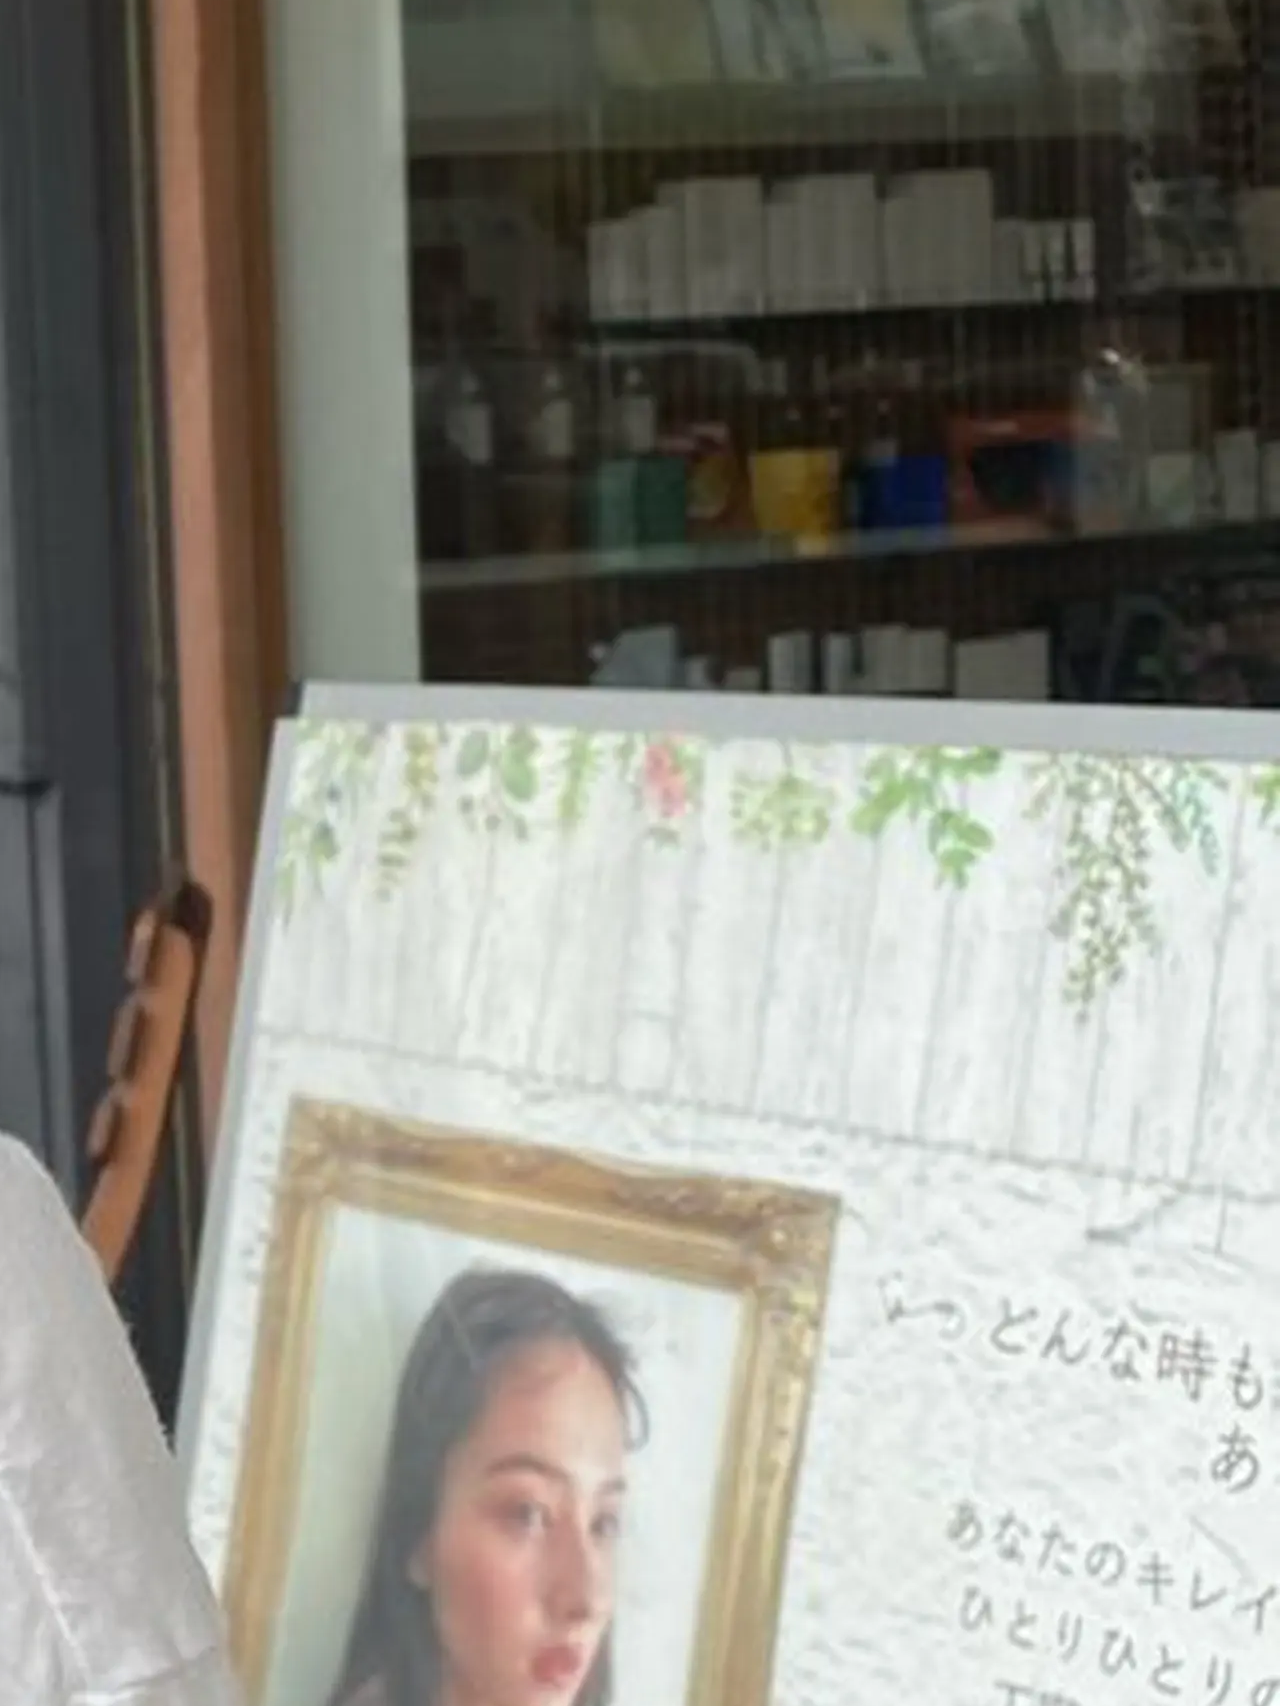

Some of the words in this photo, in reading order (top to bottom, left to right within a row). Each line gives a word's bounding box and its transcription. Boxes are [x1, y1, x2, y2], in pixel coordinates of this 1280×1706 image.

[877, 1269, 1280, 1412] いつどんな時も
[945, 1498, 1280, 1635] あなたのキレイ
